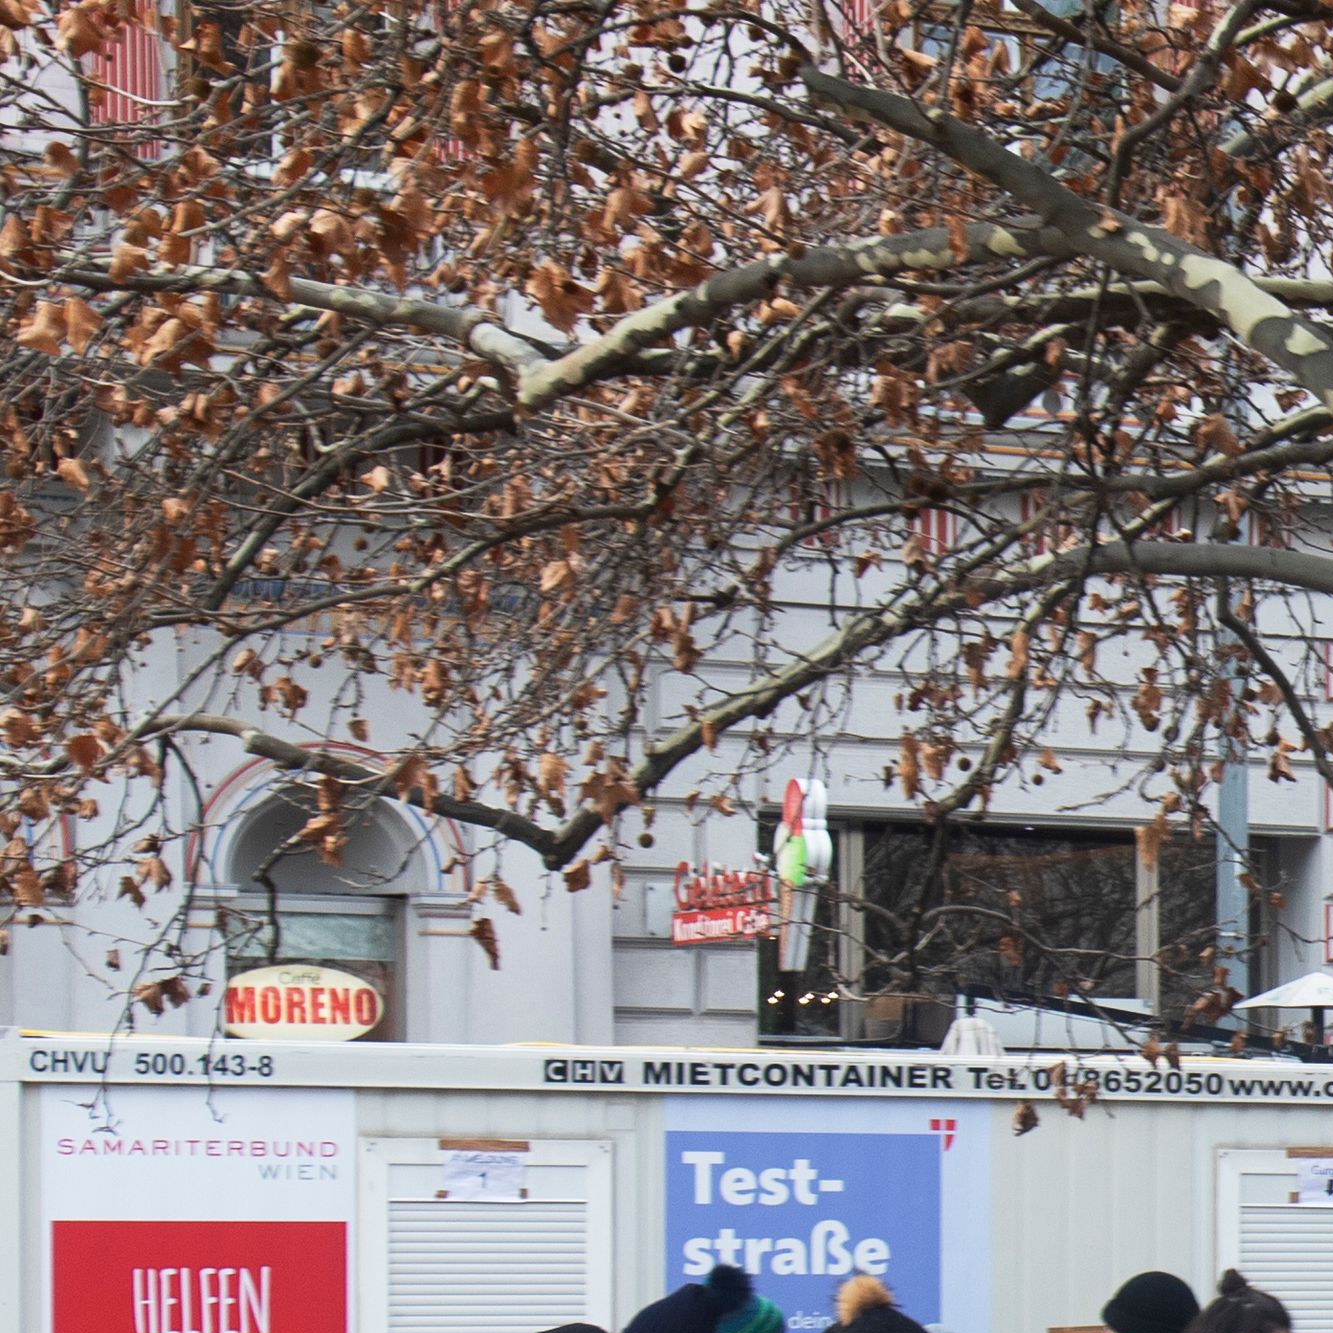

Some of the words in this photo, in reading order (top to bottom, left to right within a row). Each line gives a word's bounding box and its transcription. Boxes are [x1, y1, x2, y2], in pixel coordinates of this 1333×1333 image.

[225, 986, 378, 1026] MORENO
[29, 1050, 109, 1074] CHVU
[134, 1053, 274, 1077] 500.143-8
[544, 1059, 624, 1084] CHV
[643, 1062, 952, 1090] MIETCONTAINER
[57, 1138, 339, 1157] SAMARITERBUND
[258, 1164, 337, 1181] WIEN
[681, 1151, 844, 1205] Test-
[682, 1219, 891, 1276] straße
